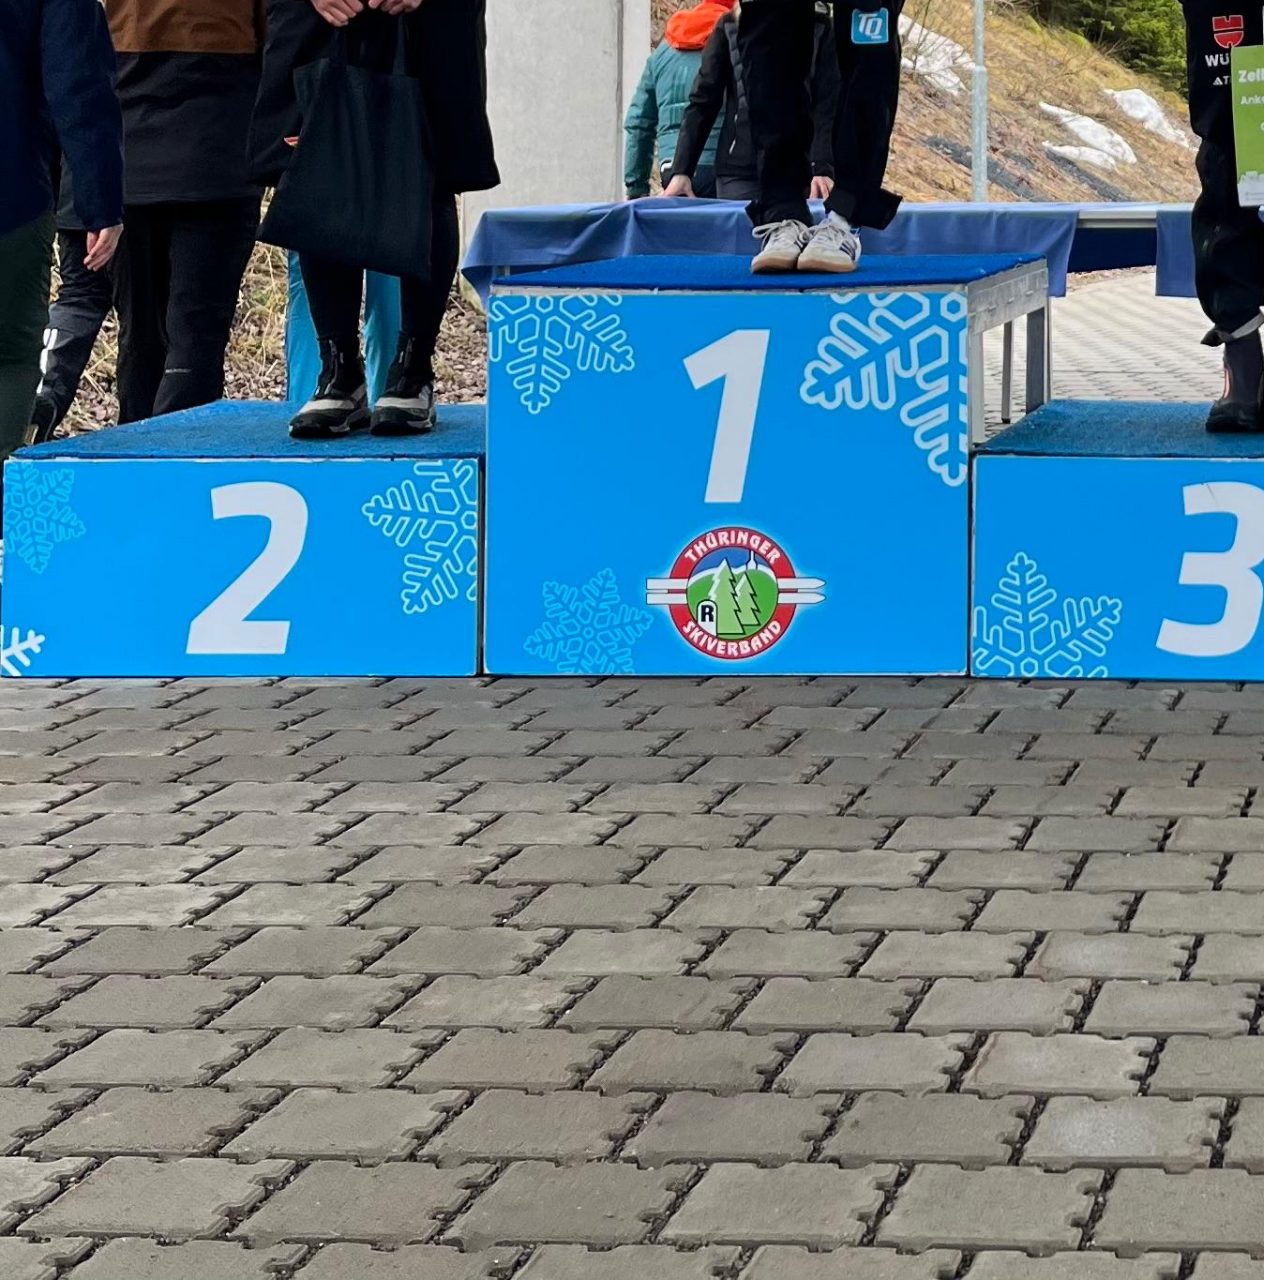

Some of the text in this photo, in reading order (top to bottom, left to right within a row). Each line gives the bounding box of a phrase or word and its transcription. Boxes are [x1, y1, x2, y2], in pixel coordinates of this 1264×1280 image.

[858, 13, 883, 39] TQ
[686, 330, 769, 503] 1
[684, 529, 781, 565] THÜRINGER
[187, 483, 308, 655] 2
[700, 604, 715, 623] R
[682, 620, 782, 657] SKIVERBAND
